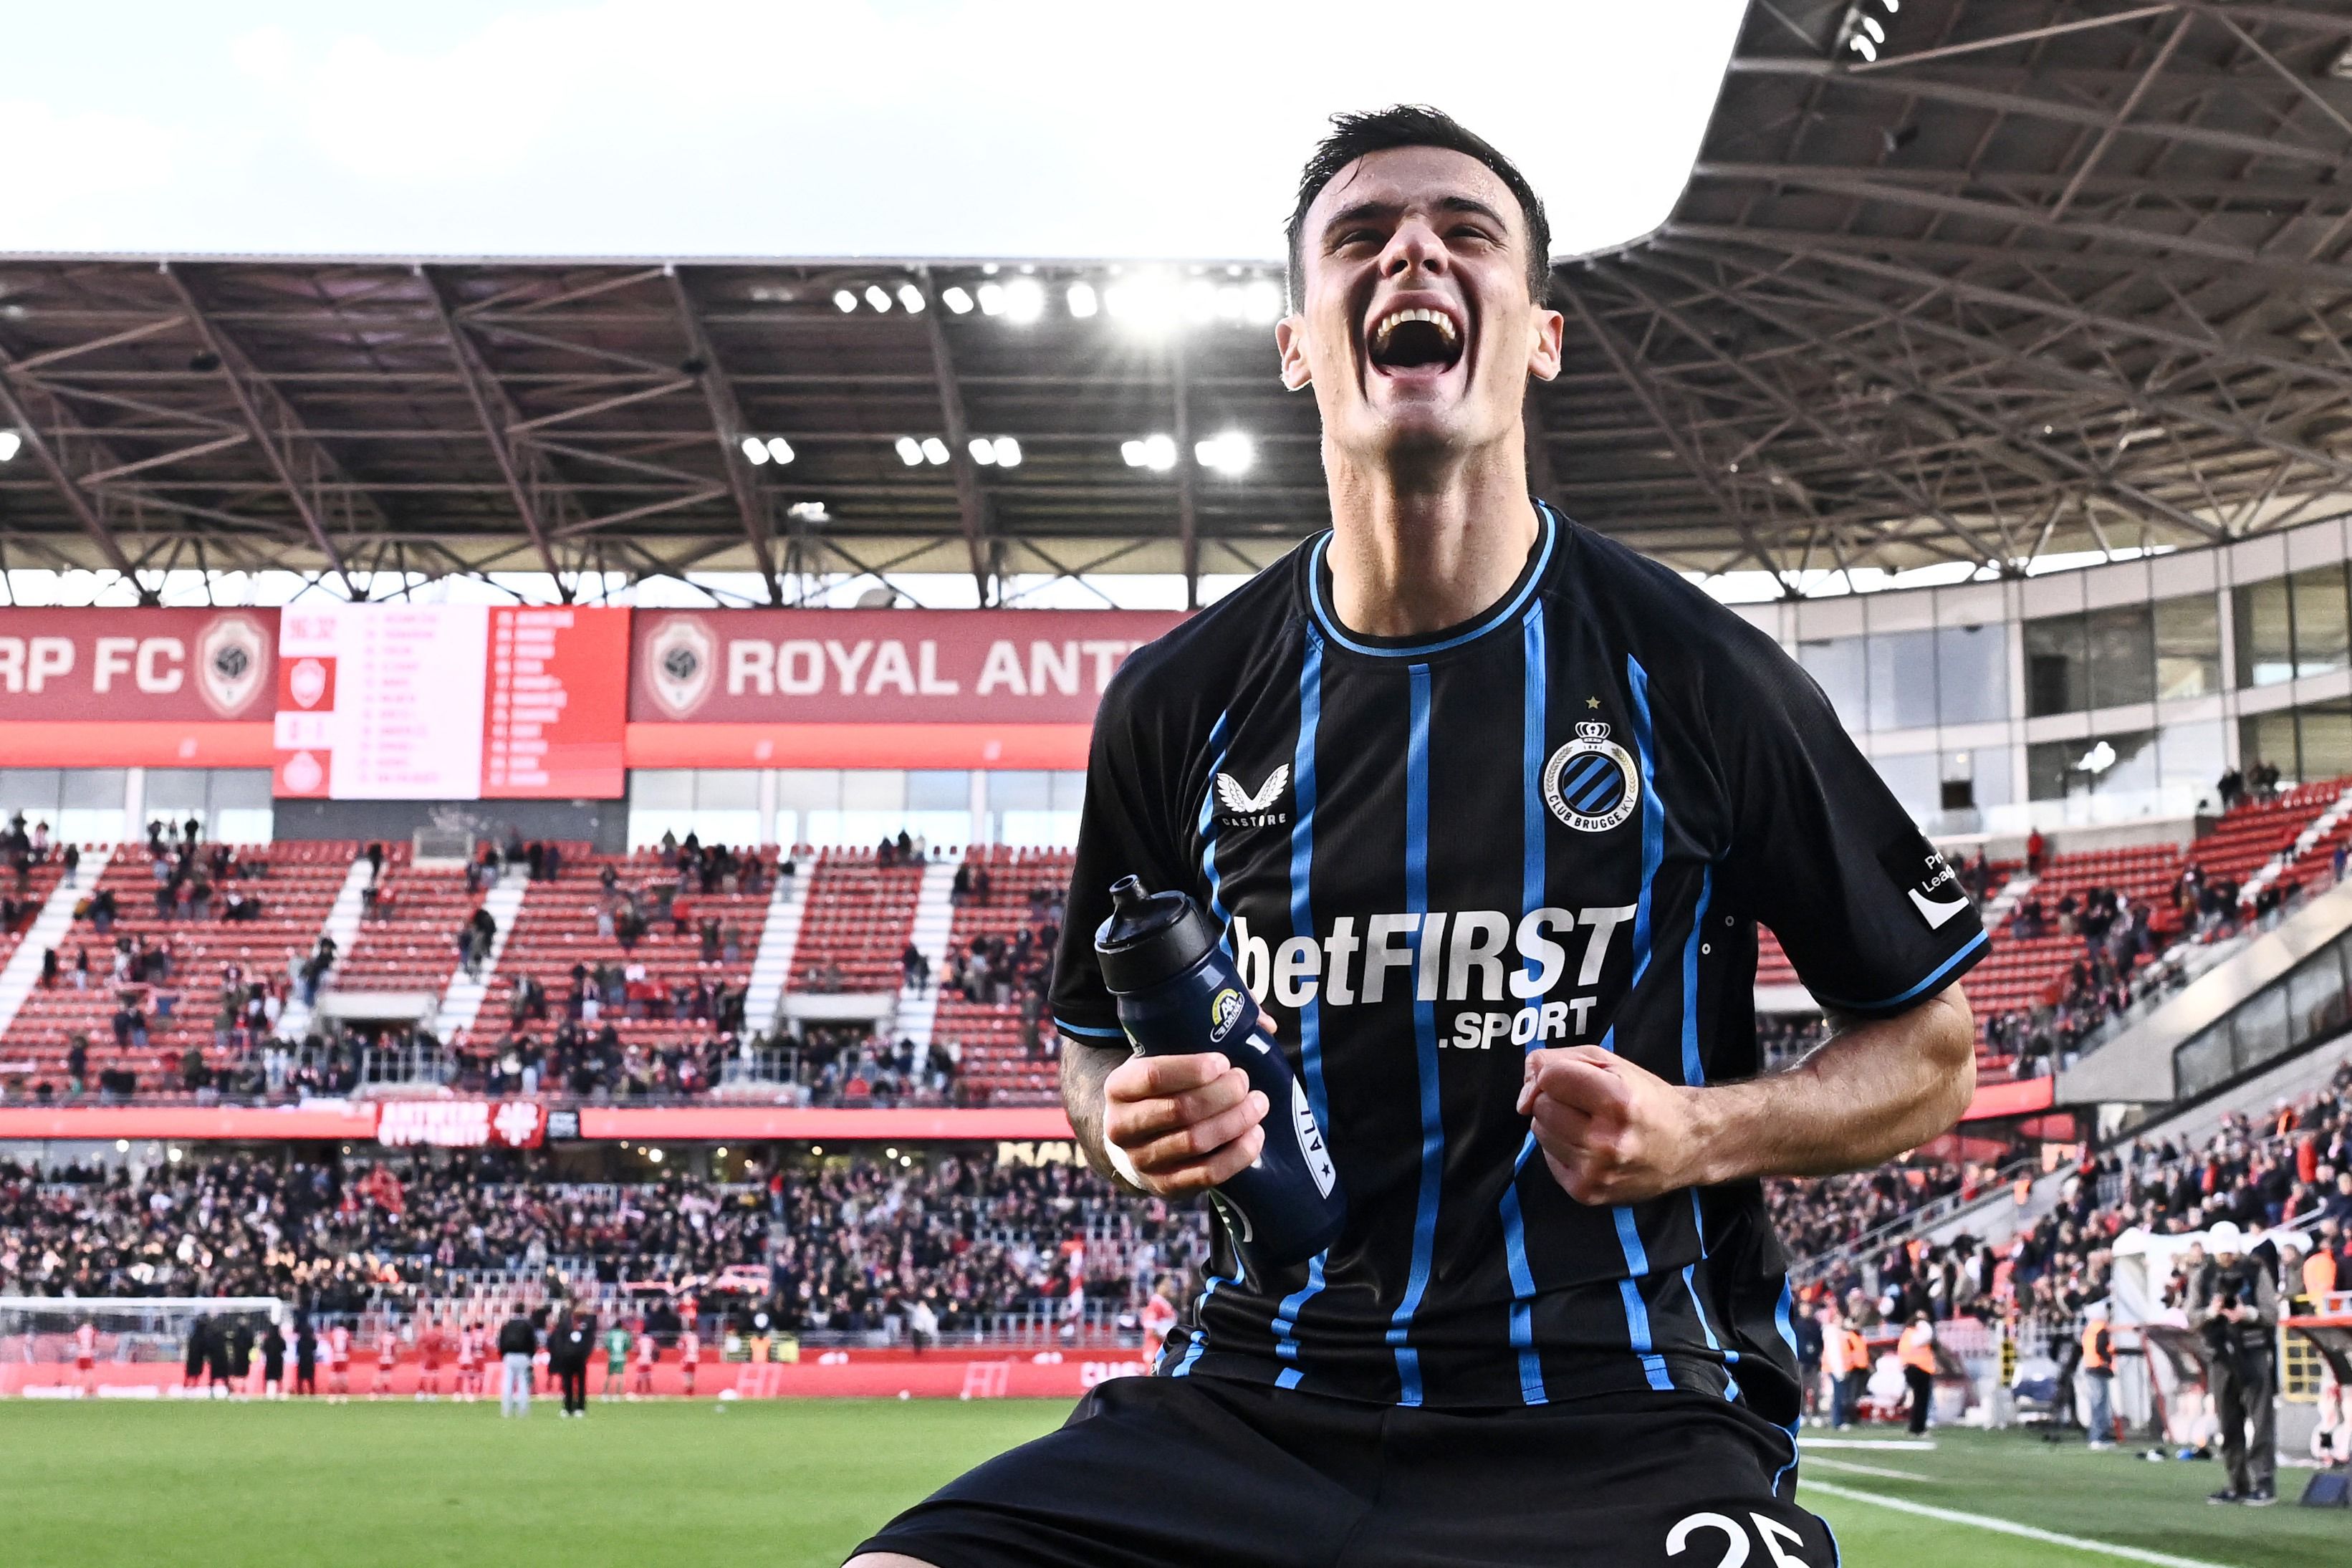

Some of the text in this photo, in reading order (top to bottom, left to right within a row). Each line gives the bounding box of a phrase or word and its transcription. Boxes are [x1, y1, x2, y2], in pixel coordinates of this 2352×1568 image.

[92, 637, 185, 693] FC
[727, 640, 1145, 696] ROYAL ANT
[1221, 813, 1286, 827] CASTORE
[1549, 794, 1634, 829] CLUB BRUGGE KV
[1924, 851, 1944, 870] Pr
[1233, 903, 1638, 1009] betFIRST
[1439, 996, 1597, 1049] .SPORT
